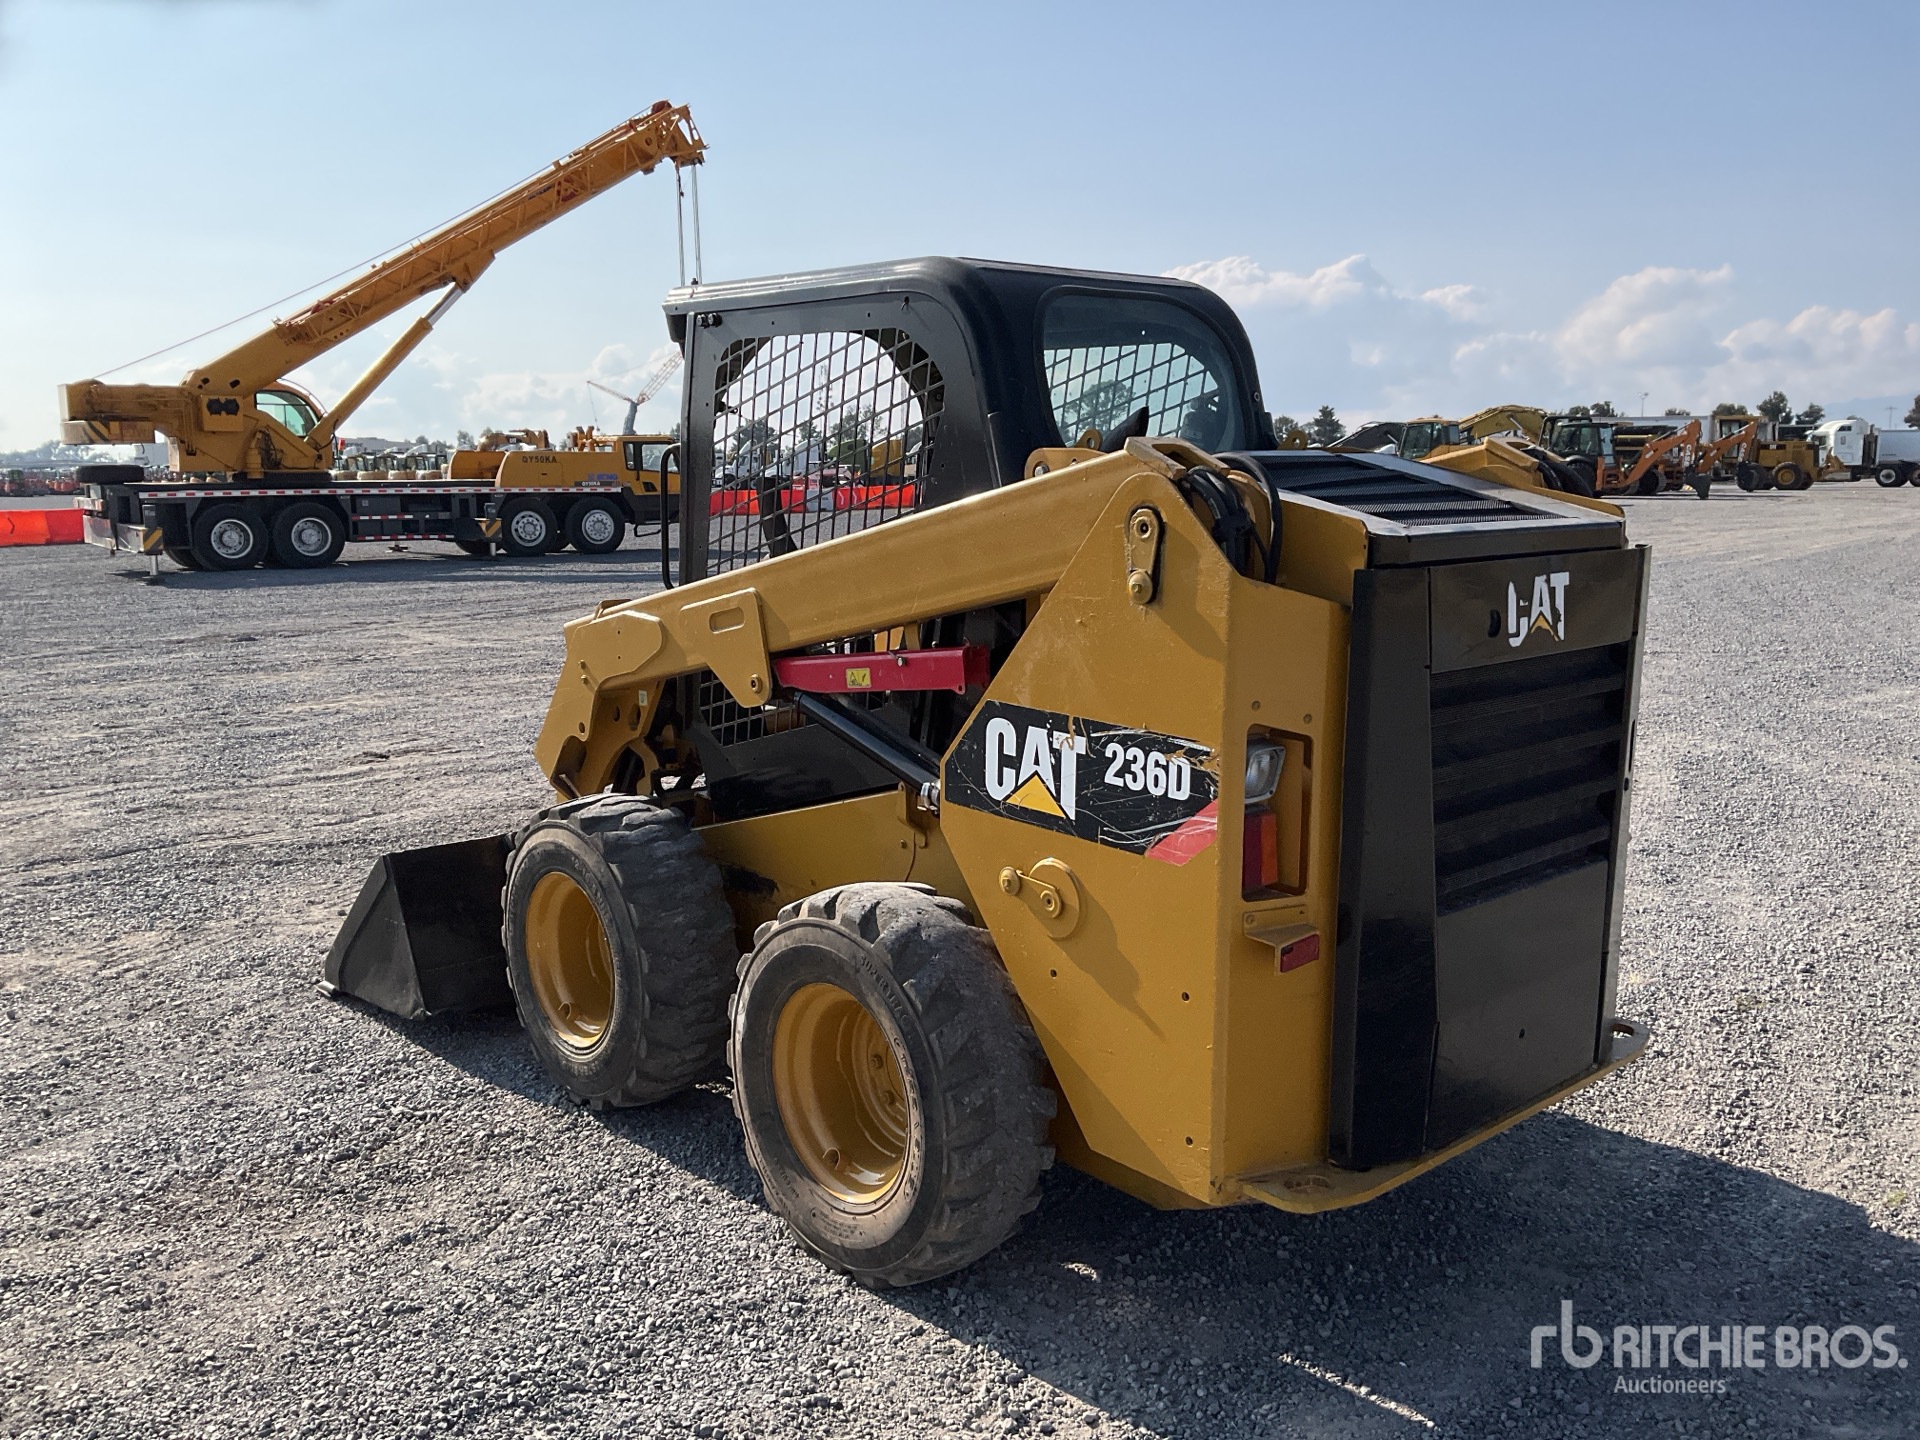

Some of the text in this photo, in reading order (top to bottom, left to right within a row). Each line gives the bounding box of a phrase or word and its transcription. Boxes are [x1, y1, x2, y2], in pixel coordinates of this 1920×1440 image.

[522, 455, 557, 464] QY50KA
[1507, 571, 1570, 648] CAT
[985, 717, 1192, 821] CAT 236D
